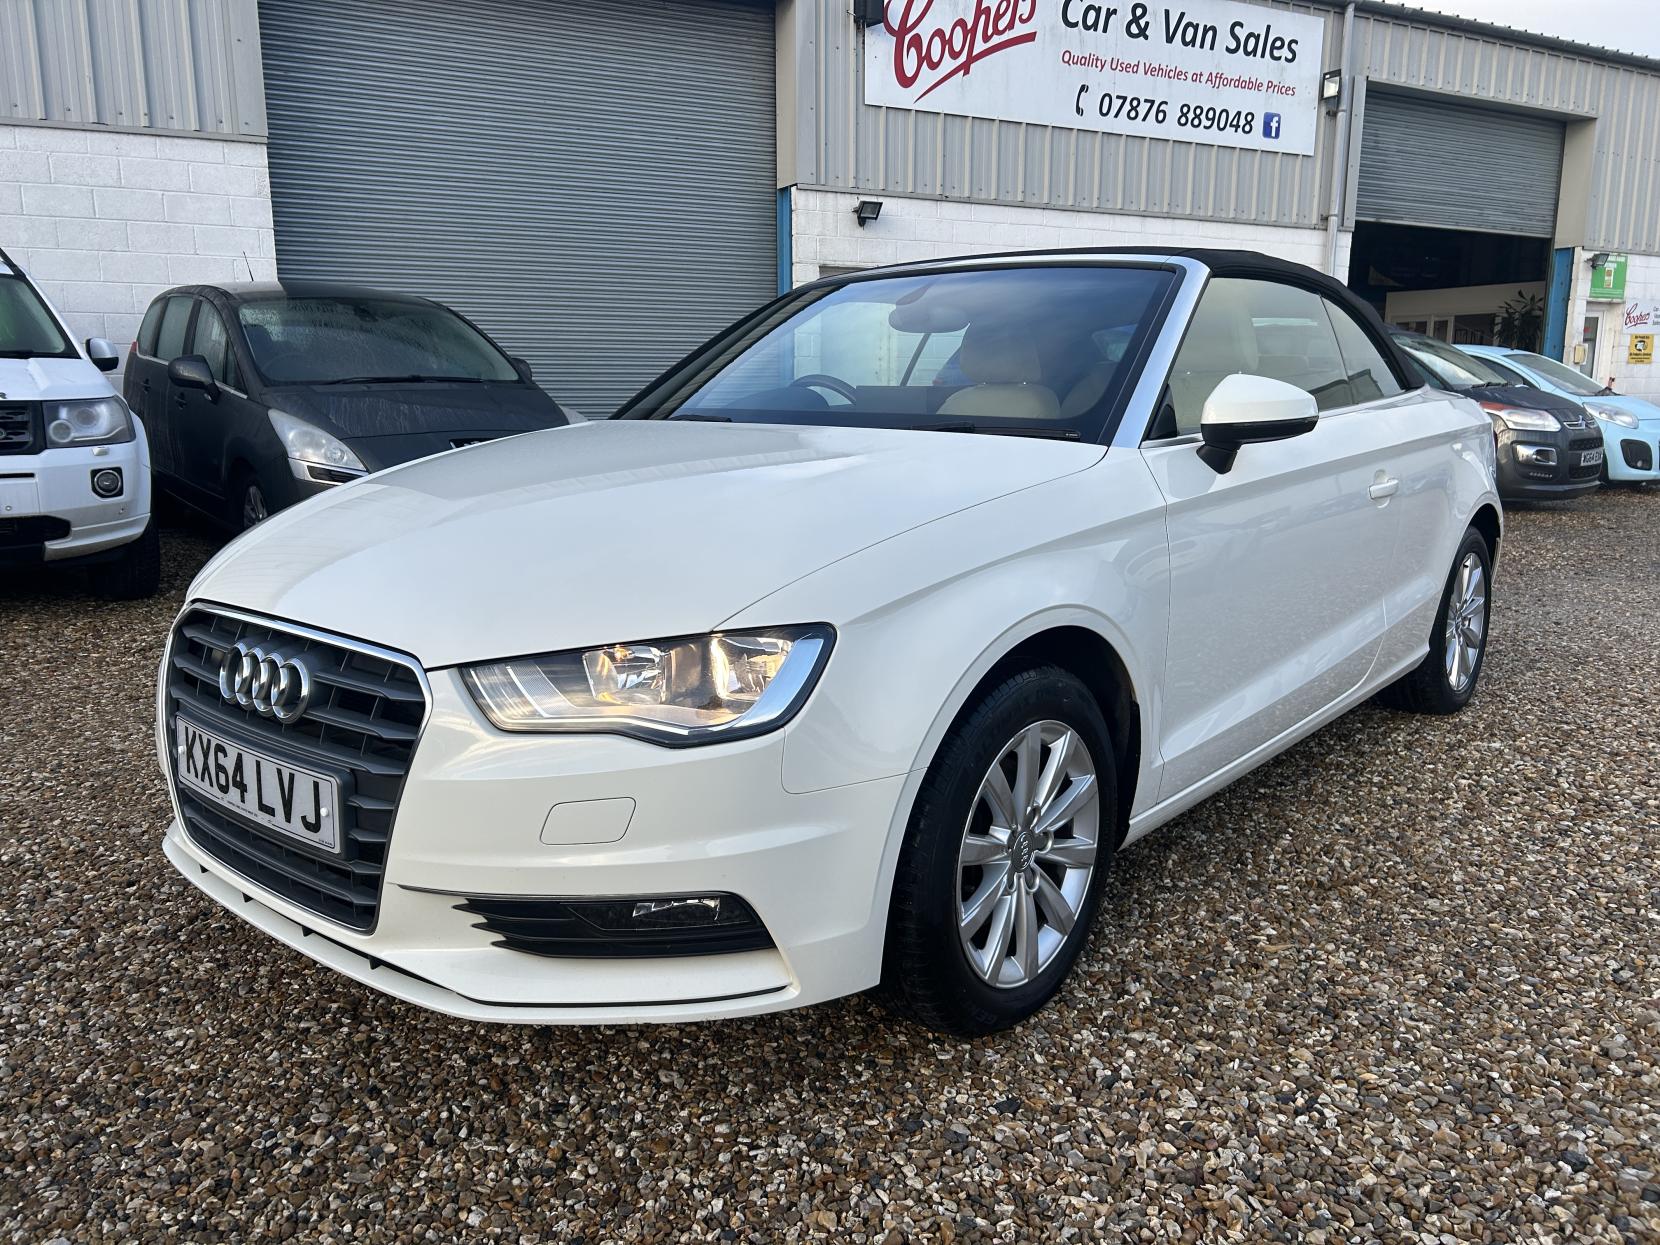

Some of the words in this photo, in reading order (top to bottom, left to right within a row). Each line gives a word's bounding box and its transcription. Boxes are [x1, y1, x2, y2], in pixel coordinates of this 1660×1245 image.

[1061, 0, 1118, 34] Car
[1125, 2, 1150, 41] &
[1163, 8, 1218, 51] Van
[1225, 20, 1299, 63] Sales
[1061, 50, 1107, 72] Quality
[1109, 58, 1140, 74] Used
[1143, 62, 1189, 82] Vehicles
[1191, 72, 1204, 84] at
[1205, 71, 1264, 92] Affordable
[1265, 80, 1296, 97] Prices
[1098, 92, 1169, 124] 07876
[1176, 103, 1255, 135] 889048
[184, 726, 248, 804] KX64
[255, 760, 321, 834] LVJ
